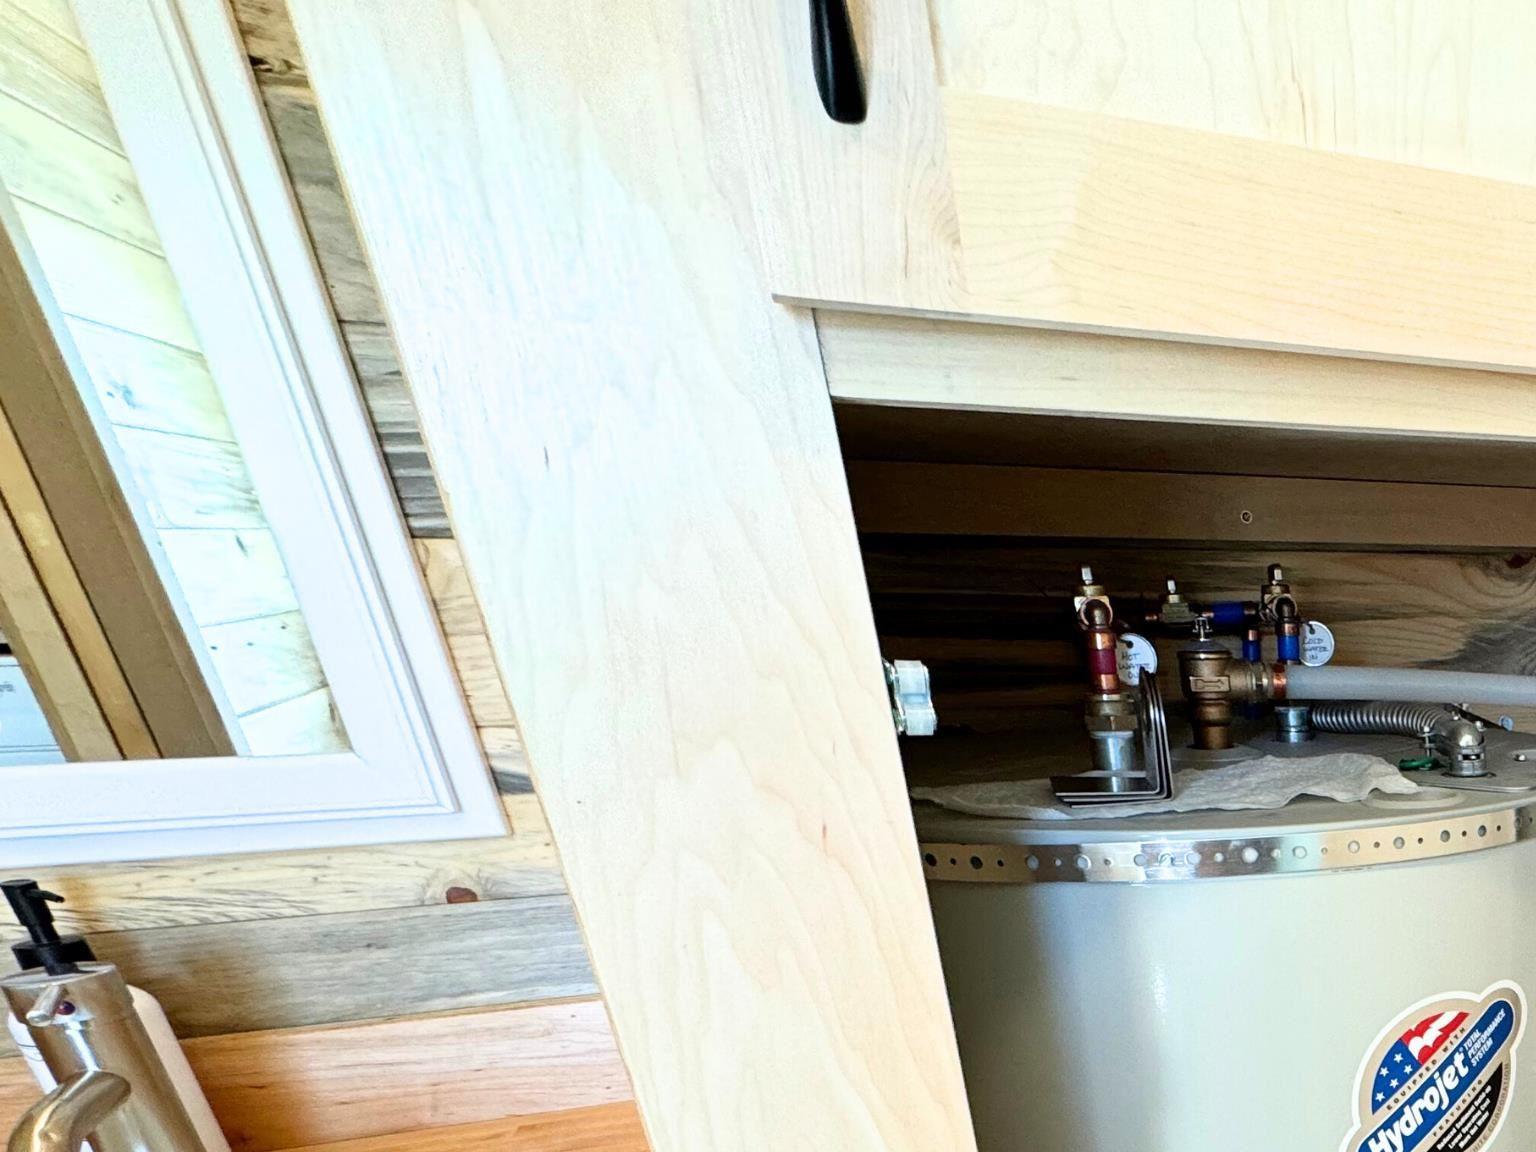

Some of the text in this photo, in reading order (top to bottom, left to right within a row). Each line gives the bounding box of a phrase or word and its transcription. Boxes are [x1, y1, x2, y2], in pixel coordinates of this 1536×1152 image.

[1121, 651, 1141, 661] HOT
[1463, 1029, 1482, 1051] TOTAL
[1467, 1008, 1507, 1059] PERFORMANCE
[1470, 1037, 1494, 1067] SYSTEM
[1386, 1026, 1466, 1111] EQUIPPED WITH
